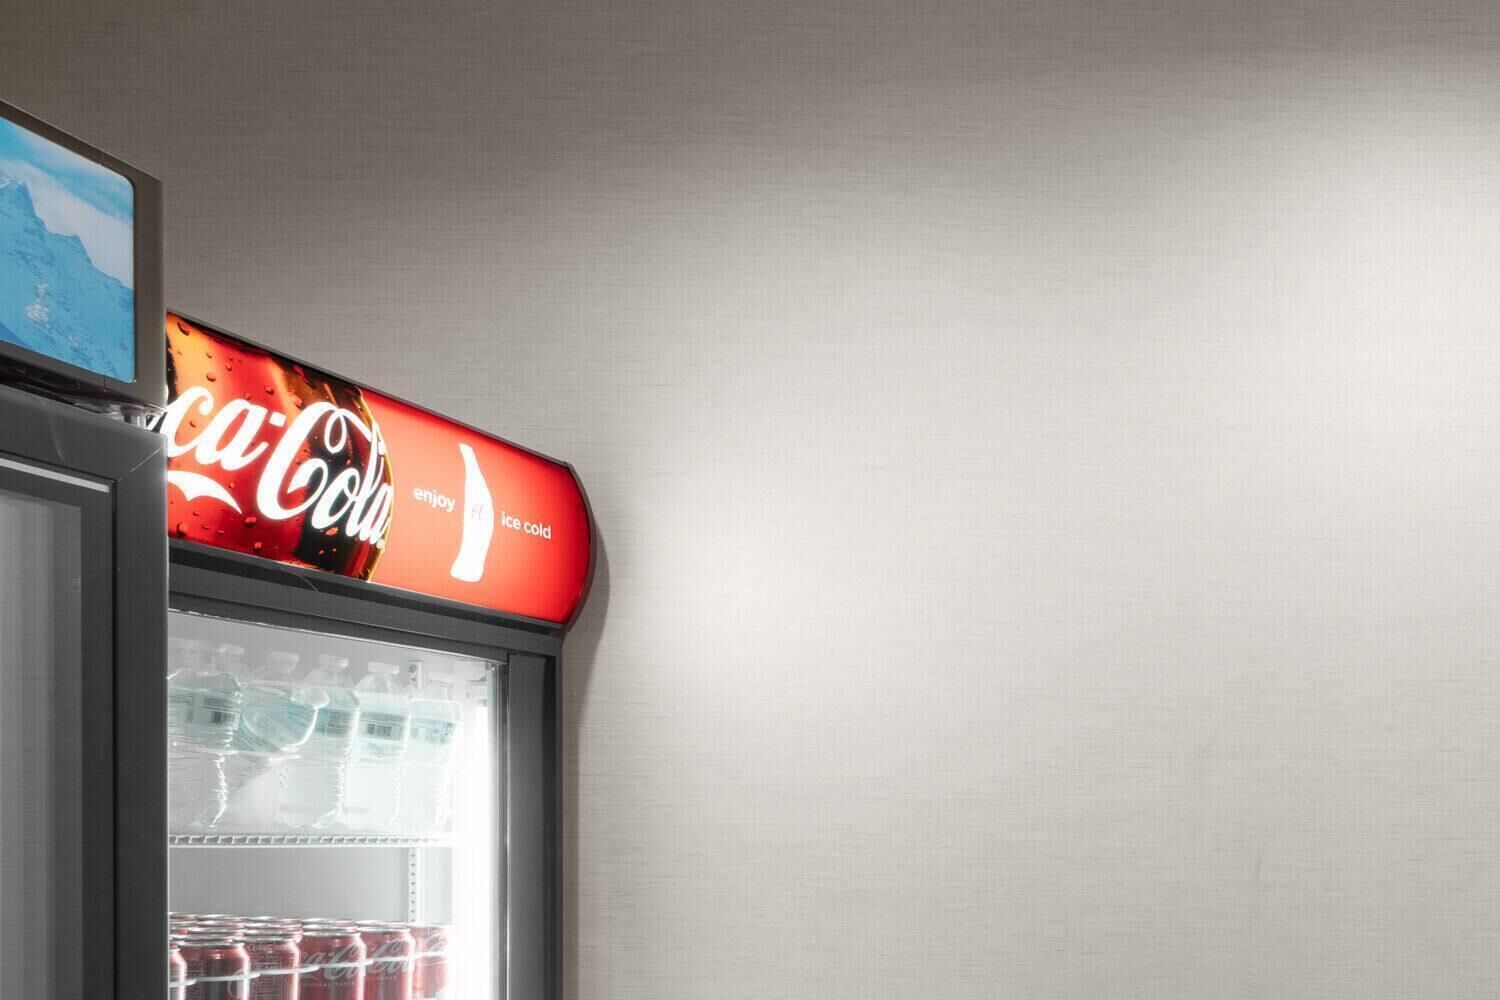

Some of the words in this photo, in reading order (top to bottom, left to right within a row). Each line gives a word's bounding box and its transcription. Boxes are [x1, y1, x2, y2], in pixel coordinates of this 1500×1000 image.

[413, 486, 456, 513] enjoy
[501, 512, 521, 531] ice
[524, 521, 552, 540] cold
